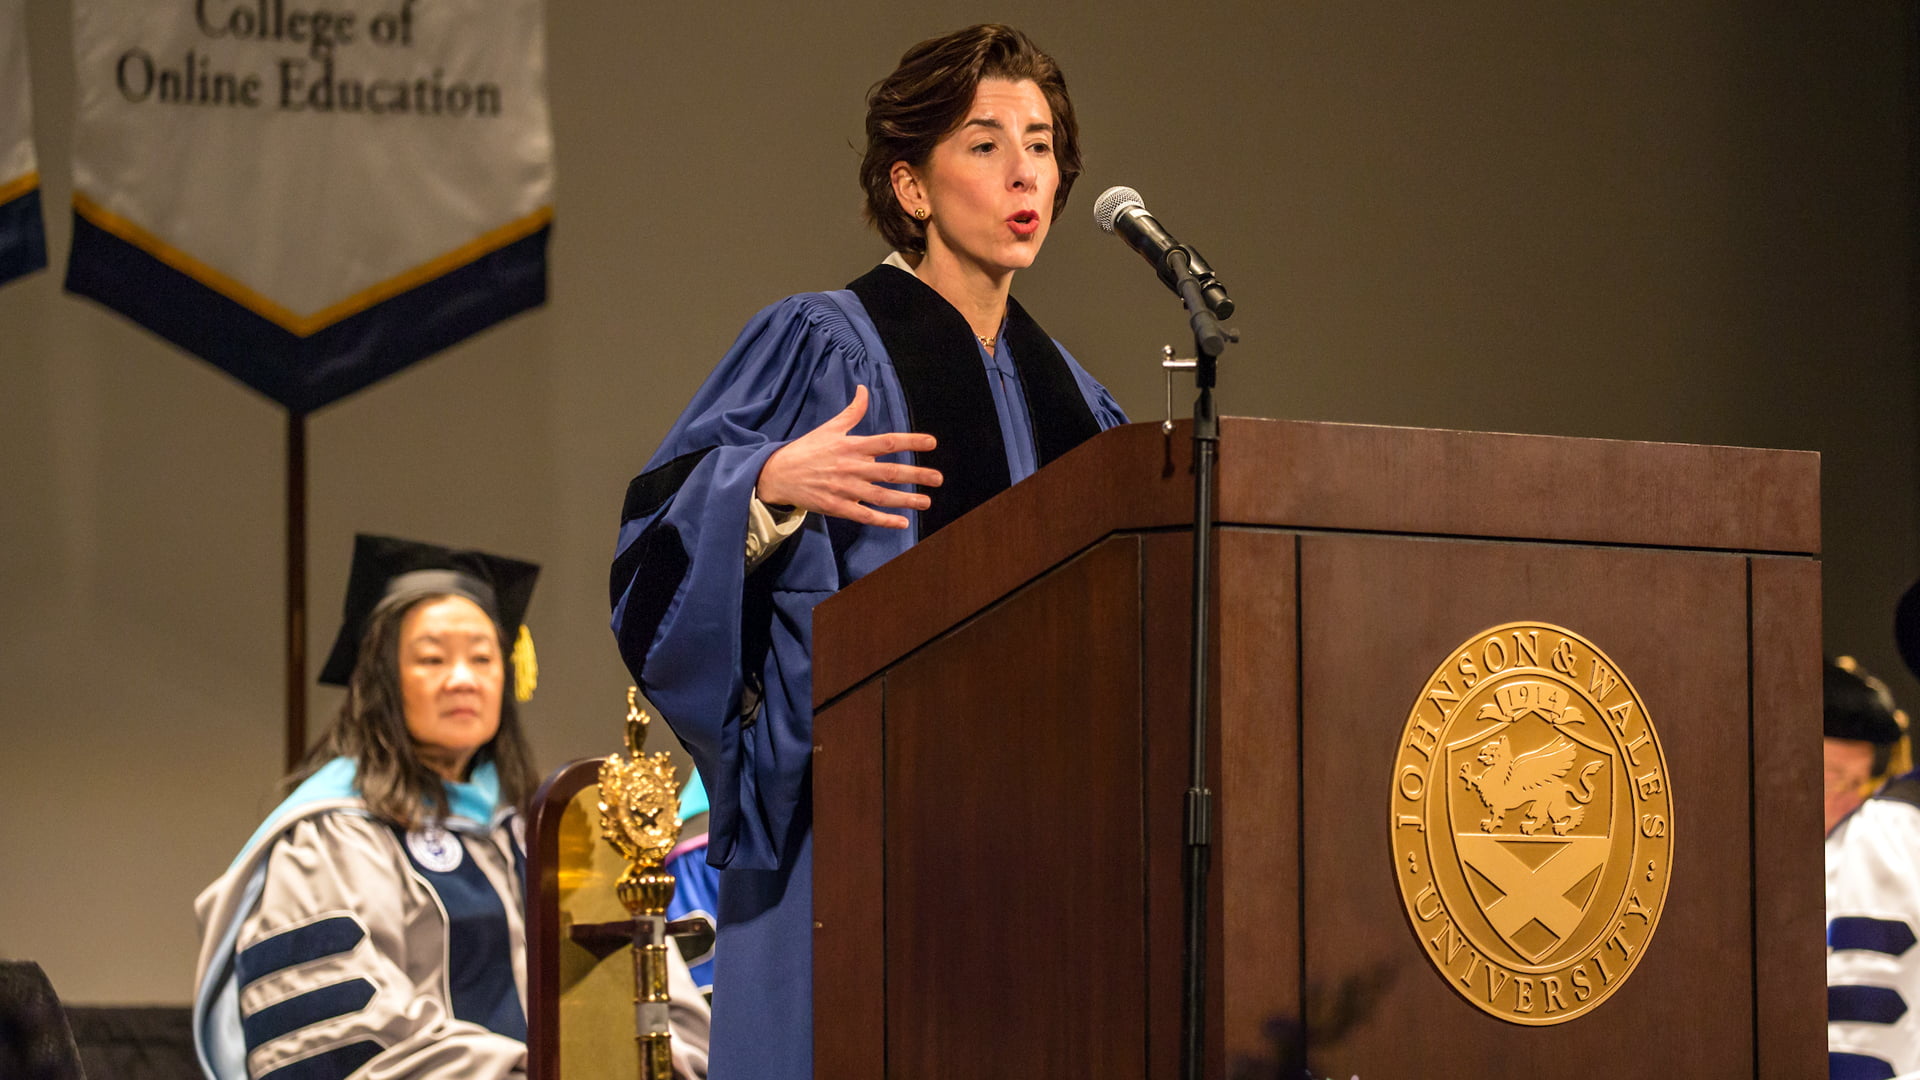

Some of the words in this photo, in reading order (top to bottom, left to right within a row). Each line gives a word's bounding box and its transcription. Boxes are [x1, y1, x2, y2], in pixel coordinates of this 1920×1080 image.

[195, 0, 355, 59] College
[370, 0, 415, 47] of
[116, 48, 260, 108] Online
[277, 56, 503, 118] Education
[1505, 686, 1559, 709] 1914
[1396, 631, 1541, 833] JOHNSON
[1551, 638, 1578, 677] &
[1589, 657, 1666, 840] WALES
[1414, 879, 1654, 1015] UNIVERSITY
